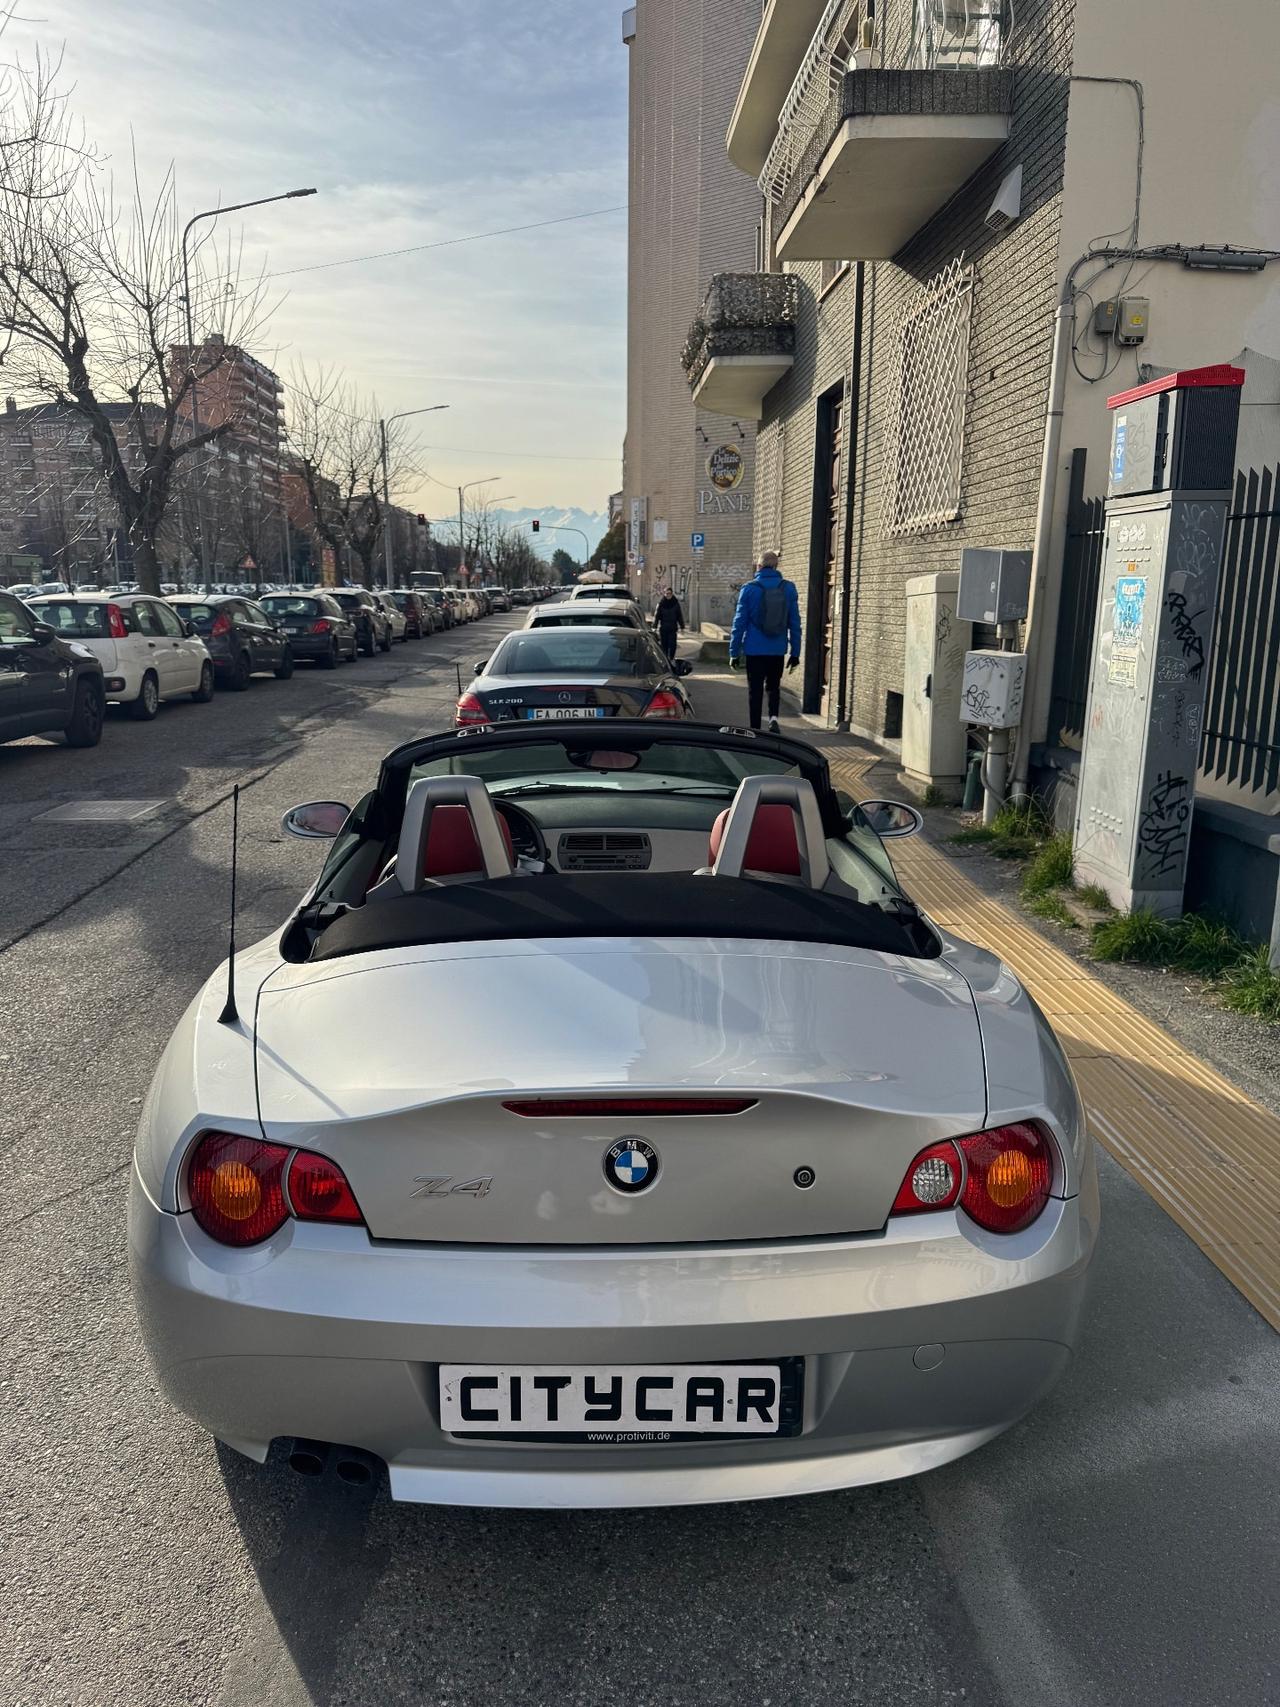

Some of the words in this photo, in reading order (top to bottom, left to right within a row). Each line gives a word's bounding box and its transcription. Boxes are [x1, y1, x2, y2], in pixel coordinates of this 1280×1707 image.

[710, 466, 738, 477] Portico
[693, 535, 702, 546] P
[610, 1140, 654, 1160] BMW
[409, 1175, 495, 1199] Z4
[459, 1375, 776, 1423] CITYCAR
[587, 1430, 671, 1443] www.protiviti.de
